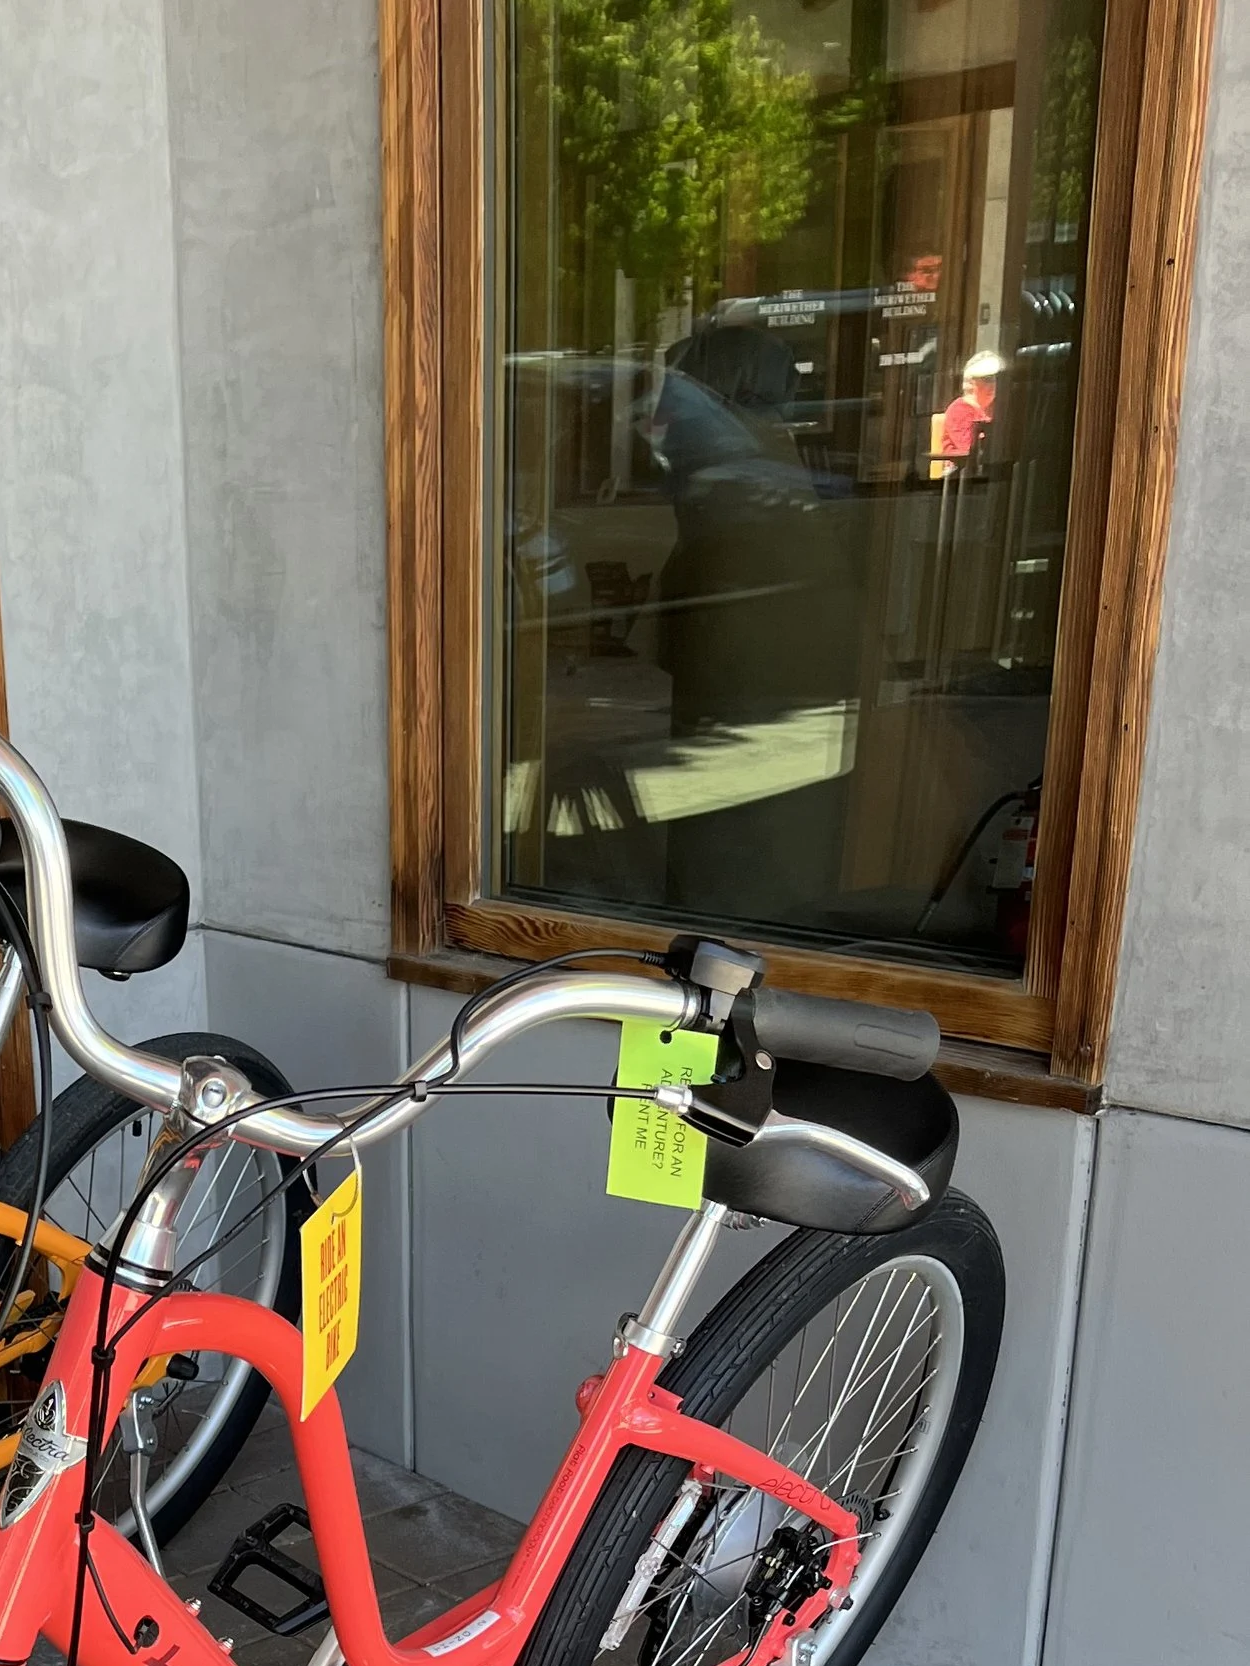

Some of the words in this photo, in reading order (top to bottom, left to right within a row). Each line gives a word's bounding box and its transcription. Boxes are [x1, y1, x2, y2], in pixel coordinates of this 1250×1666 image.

[635, 1127, 648, 1149] ME
[652, 1068, 673, 1170] ANTURE?
[672, 1122, 687, 1154] FOR
[670, 1156, 683, 1178] AN
[320, 1229, 336, 1284] RIDE
[337, 1218, 347, 1265] AN
[319, 1263, 348, 1335] ELECTRIC
[325, 1318, 341, 1372] BIKE
